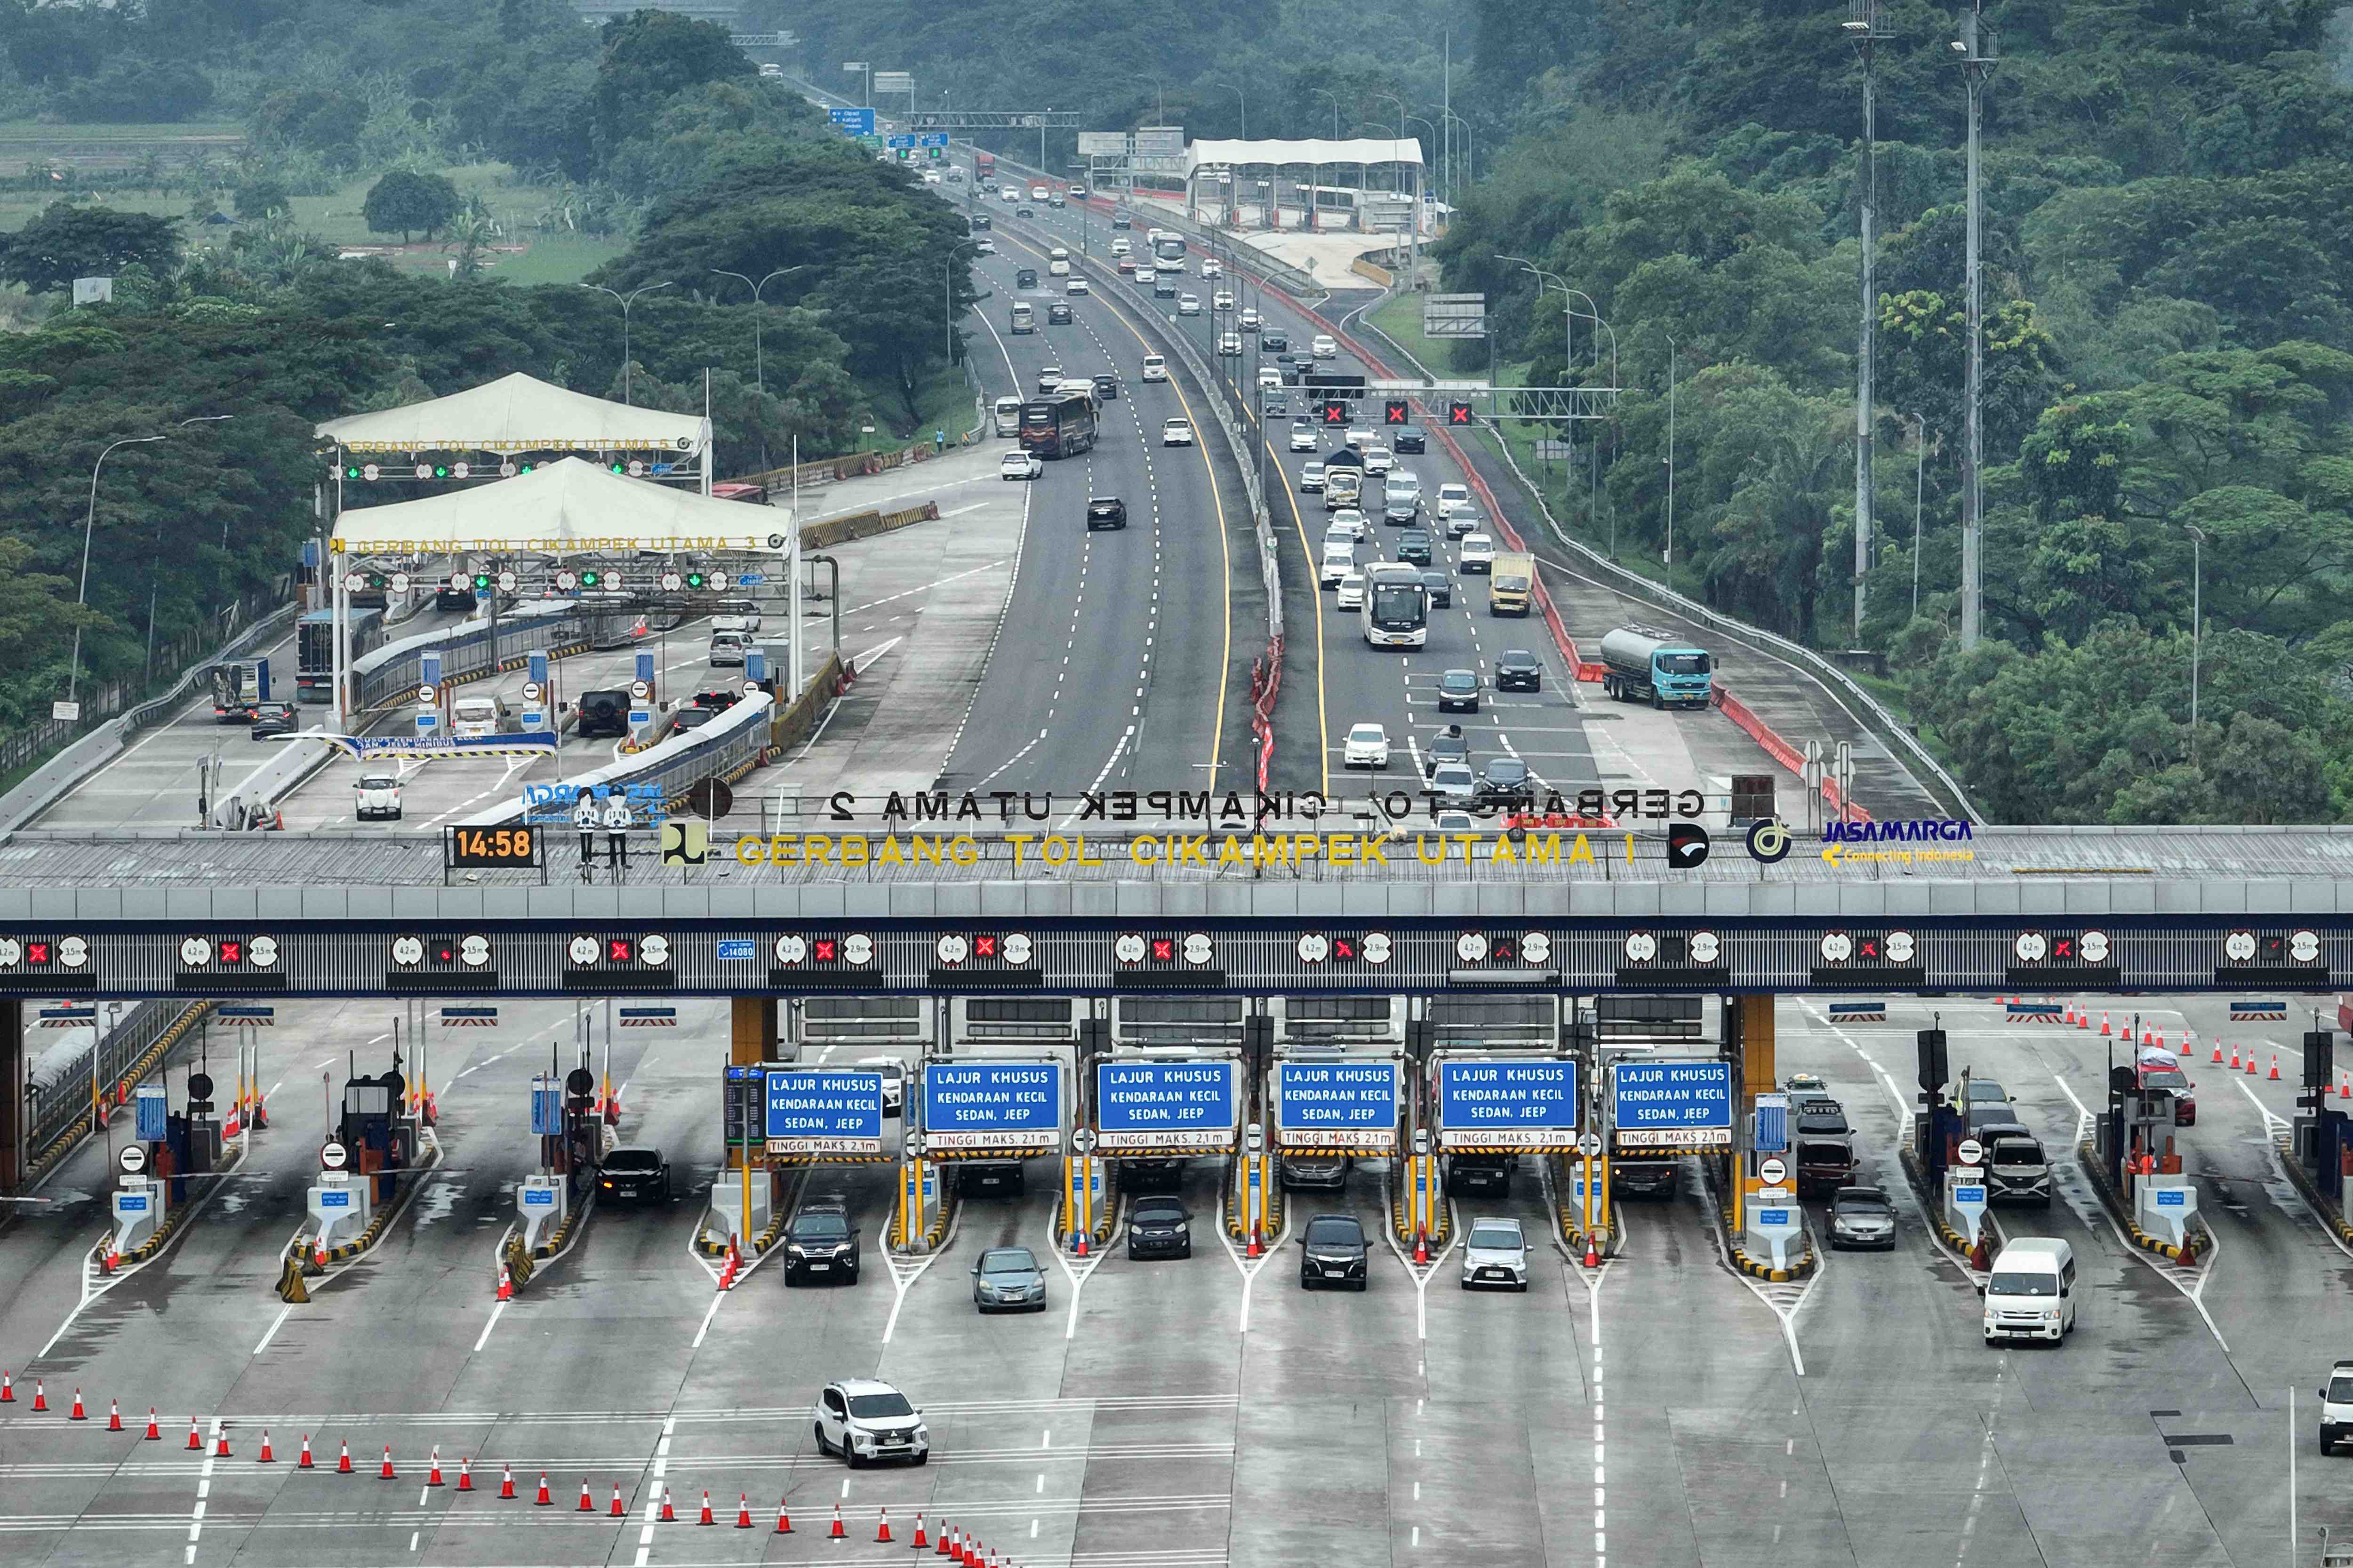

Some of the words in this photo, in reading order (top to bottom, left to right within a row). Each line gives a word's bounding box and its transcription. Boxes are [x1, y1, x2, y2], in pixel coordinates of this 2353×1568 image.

[435, 440, 471, 452] TOL
[481, 440, 576, 452] CIKAMPEK
[585, 439, 652, 451] UTAMA
[659, 439, 670, 449] 5
[358, 540, 463, 554] GERBANG
[473, 539, 515, 553] TOL
[527, 537, 640, 552] CIKAMPEK
[651, 536, 728, 551] UTAMA
[744, 536, 756, 549] 3
[1822, 820, 1973, 842] JASAMARGA
[457, 830, 530, 856] 14:58
[736, 835, 978, 867] GERBANG
[1005, 834, 1103, 867] TOL
[1131, 834, 1389, 866] CIKAMPEK
[1417, 833, 1595, 866] UTAMA
[1844, 849, 1912, 866] Connecting
[1915, 848, 1974, 862] Indonesia
[729, 947, 753, 957] 14080
[937, 1072, 982, 1085] LAJUR
[991, 1071, 1048, 1084] KHUSUS
[1110, 1071, 1153, 1084] LAJUR
[1164, 1070, 1221, 1083] KHUSUS
[1286, 1070, 1329, 1082] LAJUR
[1336, 1070, 1390, 1082] KHUSUS
[1452, 1069, 1498, 1081] LAJUR
[1507, 1069, 1564, 1081] KHUSUS
[1620, 1070, 1664, 1082] LAJUR
[1671, 1069, 1725, 1081] KHUSUS
[772, 1079, 816, 1091] LAJUR
[823, 1079, 877, 1092] KHUSUS
[937, 1092, 1010, 1104] KENDARAAN
[1016, 1092, 1047, 1103] KECIL
[1110, 1091, 1183, 1103] KENDARAAN
[1189, 1090, 1221, 1102] KECIL
[1285, 1090, 1355, 1101] KENDARAAN
[1360, 1089, 1391, 1101] KECIL
[1453, 1089, 1527, 1101] KENDARAAN
[1532, 1089, 1564, 1100] KECIL
[1620, 1089, 1689, 1102] KENDARAAN
[1695, 1088, 1726, 1100] KECIL
[771, 1099, 842, 1110] KENDARAAN
[846, 1099, 877, 1111] KECIL
[956, 1109, 997, 1122] SEDAN,
[1003, 1109, 1030, 1120] JEEP
[1128, 1108, 1171, 1120] SEDAN,
[1176, 1107, 1204, 1119] JEEP
[1302, 1109, 1345, 1121] SEDAN,
[1348, 1109, 1375, 1120] JEEP
[1471, 1107, 1513, 1119] SEDAN,
[1520, 1106, 1547, 1118] JEEP
[1637, 1108, 1680, 1120] SEDAN,
[1683, 1108, 1710, 1120] JEEP
[784, 1117, 829, 1130] SEDAN,
[835, 1118, 863, 1129] JEEP
[937, 1136, 976, 1146] TINGGI
[1110, 1135, 1148, 1145] TINGGI
[1285, 1133, 1323, 1145] TINGGI
[1453, 1133, 1491, 1144] TINGGI
[1621, 1133, 1659, 1144] TINGGI
[770, 1141, 808, 1151] TINGGI
